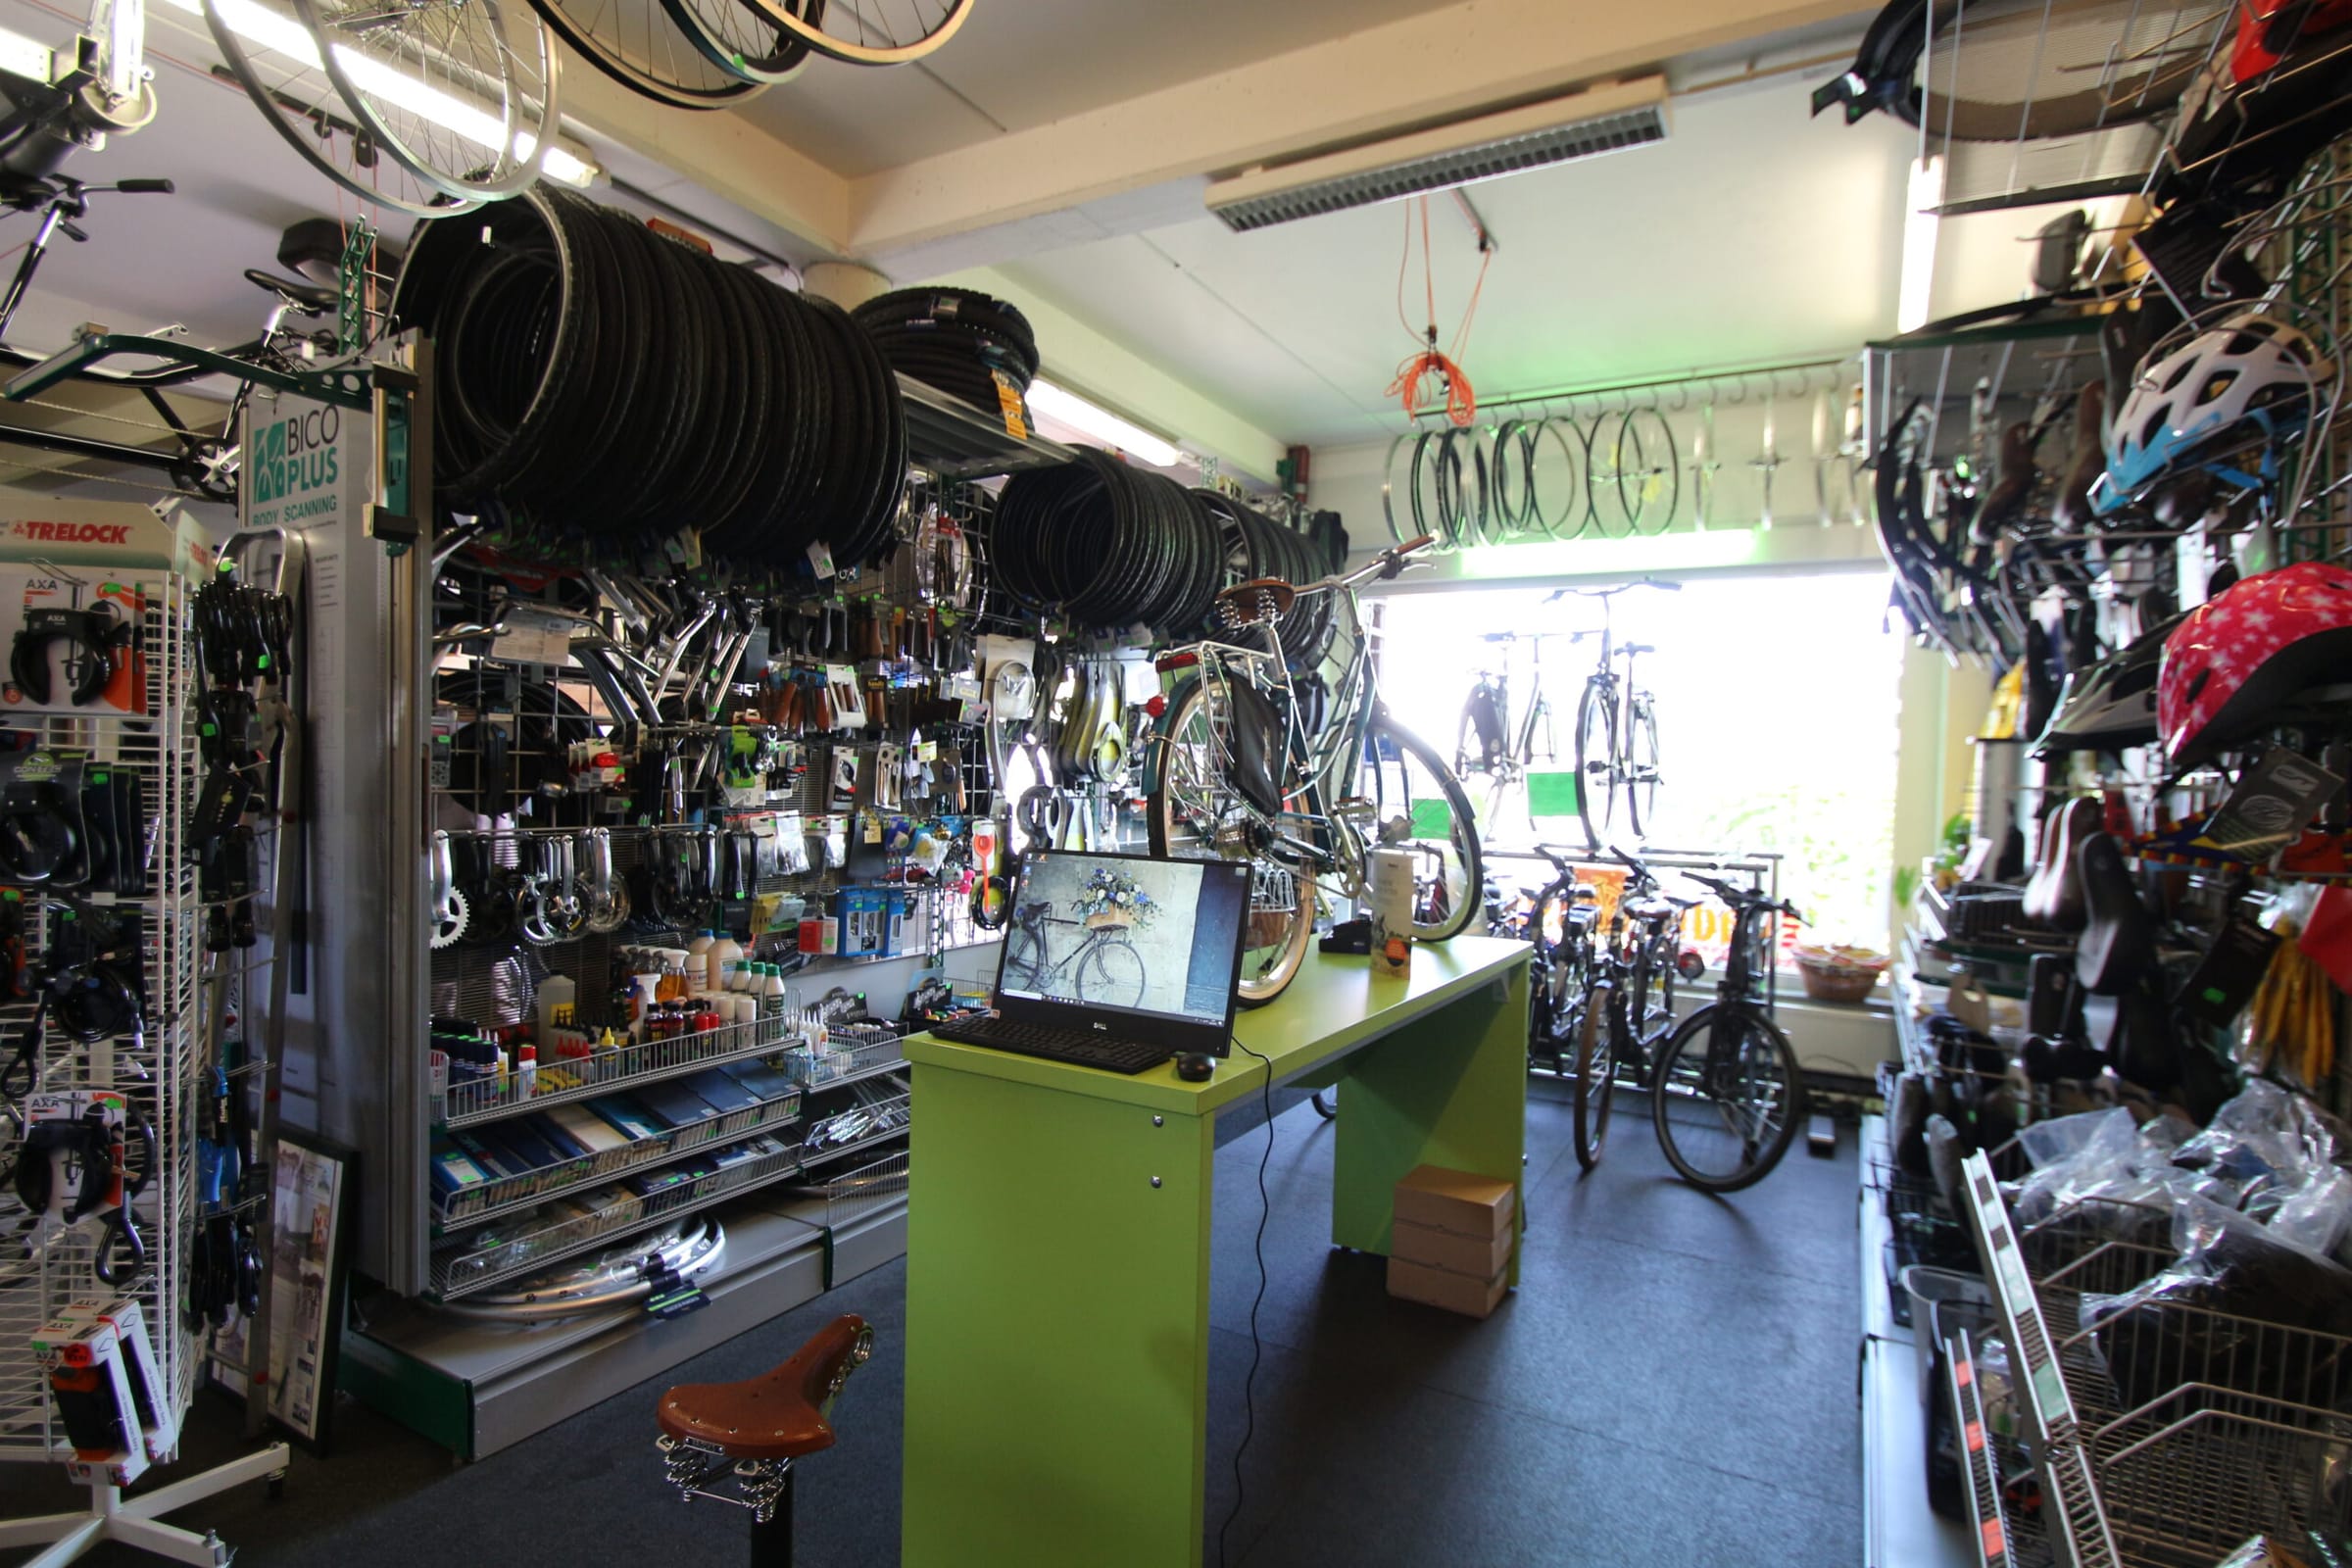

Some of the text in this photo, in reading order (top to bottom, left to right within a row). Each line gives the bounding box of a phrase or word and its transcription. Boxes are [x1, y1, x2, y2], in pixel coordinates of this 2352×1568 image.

[288, 405, 339, 456] BICO
[288, 447, 338, 495] PLUS
[253, 510, 279, 526] BODY
[284, 494, 337, 522] SCANNING
[26, 520, 133, 544] TRELOCK
[25, 579, 58, 590] AXA
[31, 1098, 60, 1108] AXA
